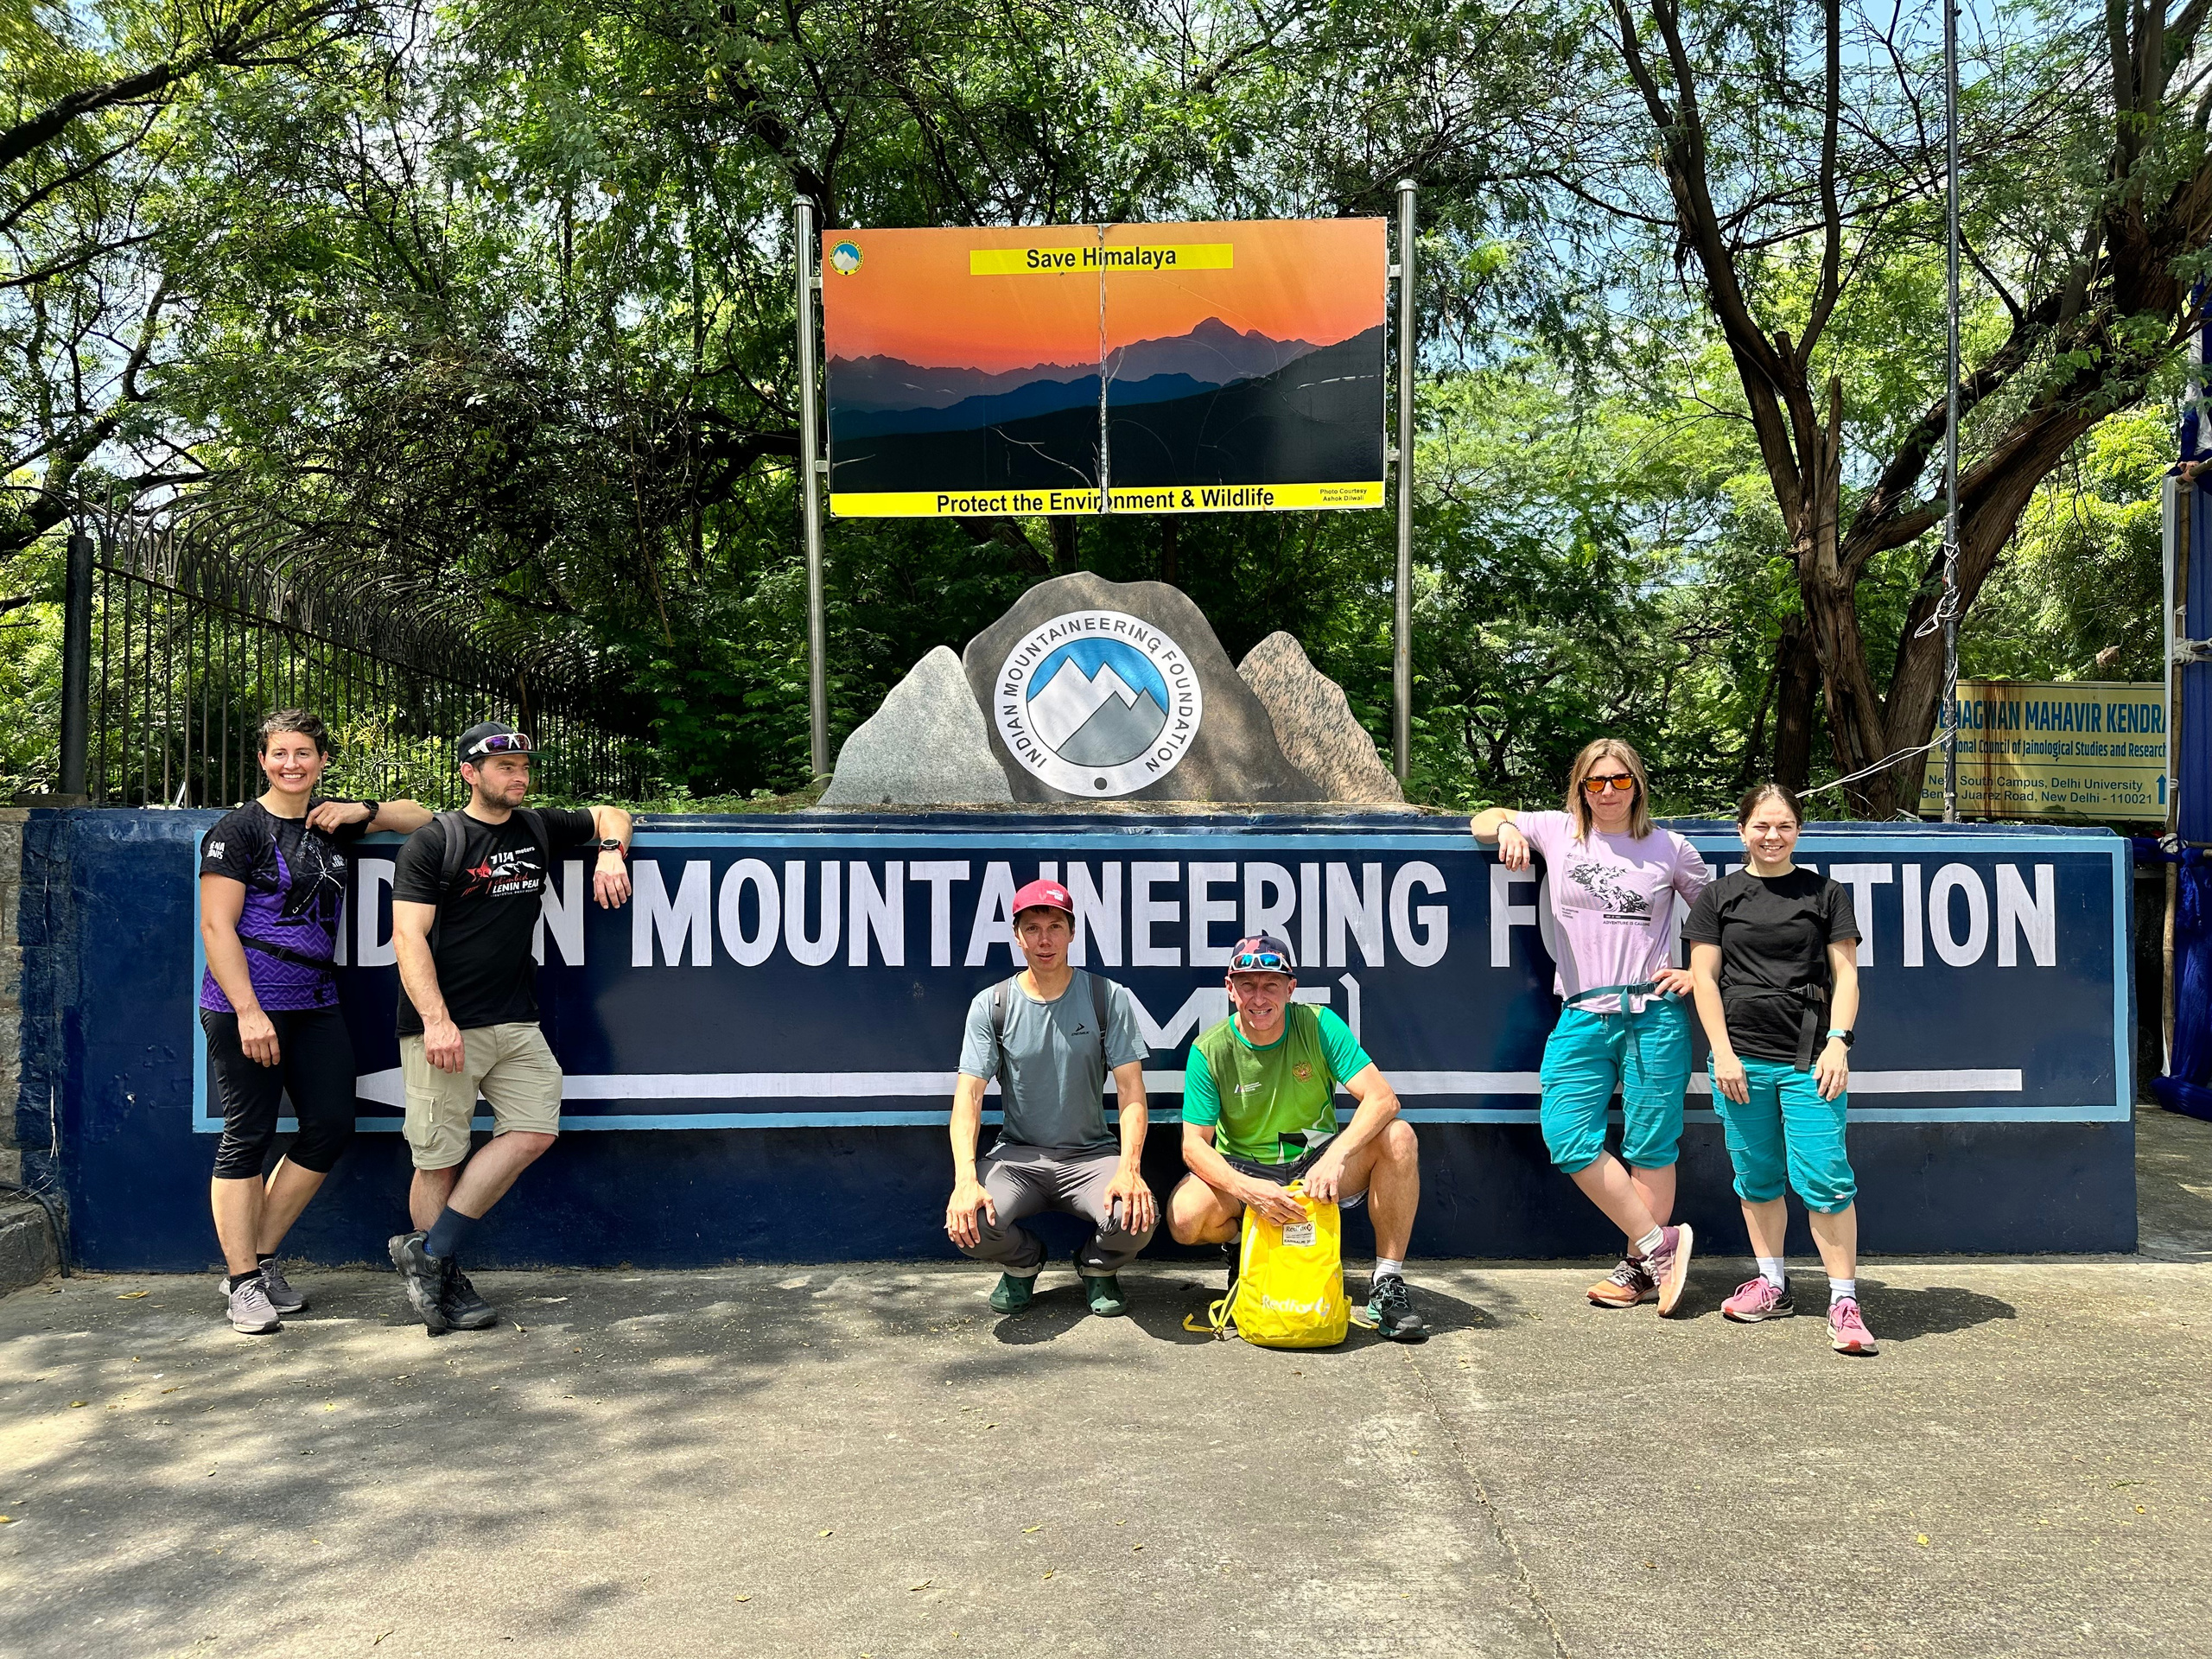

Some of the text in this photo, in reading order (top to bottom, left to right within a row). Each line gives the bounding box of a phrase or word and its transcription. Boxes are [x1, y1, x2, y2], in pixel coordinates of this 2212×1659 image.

[1026, 246, 1177, 270] Save Himalaya
[937, 493, 1007, 512] Protect
[1013, 493, 1044, 512] the
[1180, 489, 1196, 508] &
[1201, 487, 1274, 507] Wildlife
[1002, 617, 1193, 772] INDIAN MOUNTAINEERING FOUNDATION
[2024, 701, 2102, 733] MAHAVIR
[2106, 703, 2166, 734] KENDR
[1940, 739, 1977, 753] Nional
[1979, 739, 2010, 754] Council
[2012, 739, 2021, 754] of
[2022, 739, 2074, 758] Jainological
[2075, 741, 2108, 757] Studies
[2109, 742, 2126, 757] and
[1929, 775, 2143, 793] Ne South Campus, Delhi University
[1961, 790, 2001, 800] Juarez
[2004, 791, 2038, 804] Road,
[2041, 791, 2067, 802] New
[2069, 792, 2100, 804] Delhi
[2110, 793, 2152, 804] 110021
[515, 846, 536, 855] meters
[492, 880, 520, 894] LENIN
[632, 858, 1449, 968] MOUNTANEERING
[1490, 861, 2056, 968] FTION
